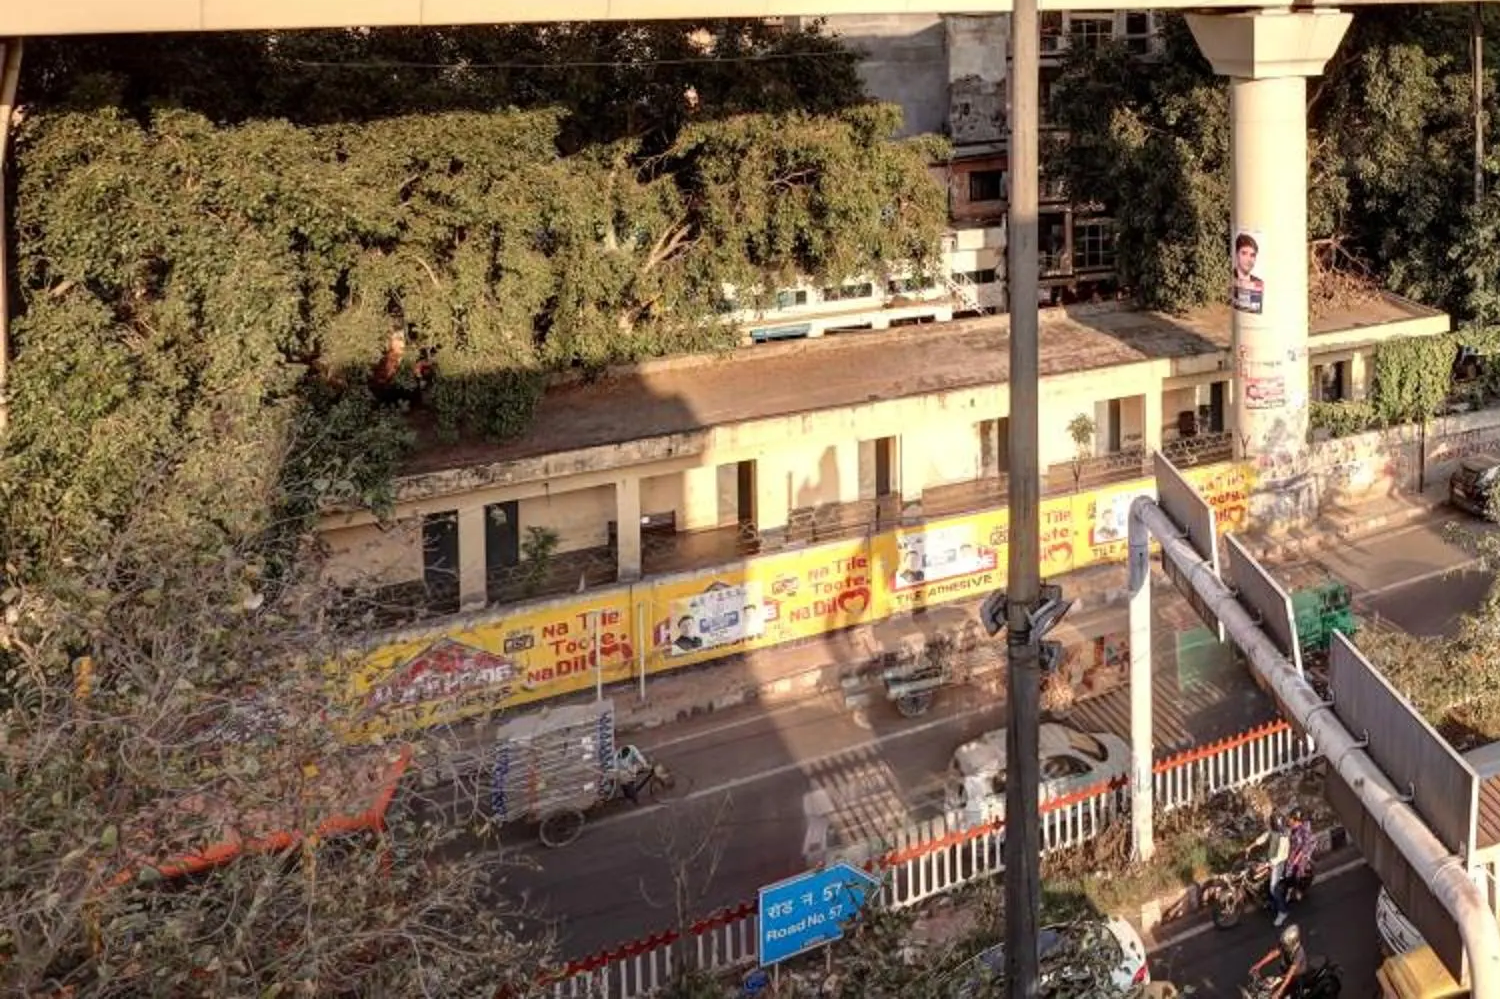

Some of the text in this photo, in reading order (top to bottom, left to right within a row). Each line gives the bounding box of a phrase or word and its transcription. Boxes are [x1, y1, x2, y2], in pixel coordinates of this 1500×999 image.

[542, 609, 620, 639] Na Tle
[527, 654, 587, 684] Na Dil
[822, 881, 843, 903] 57
[766, 918, 806, 943] Road
[828, 903, 843, 921] 57
